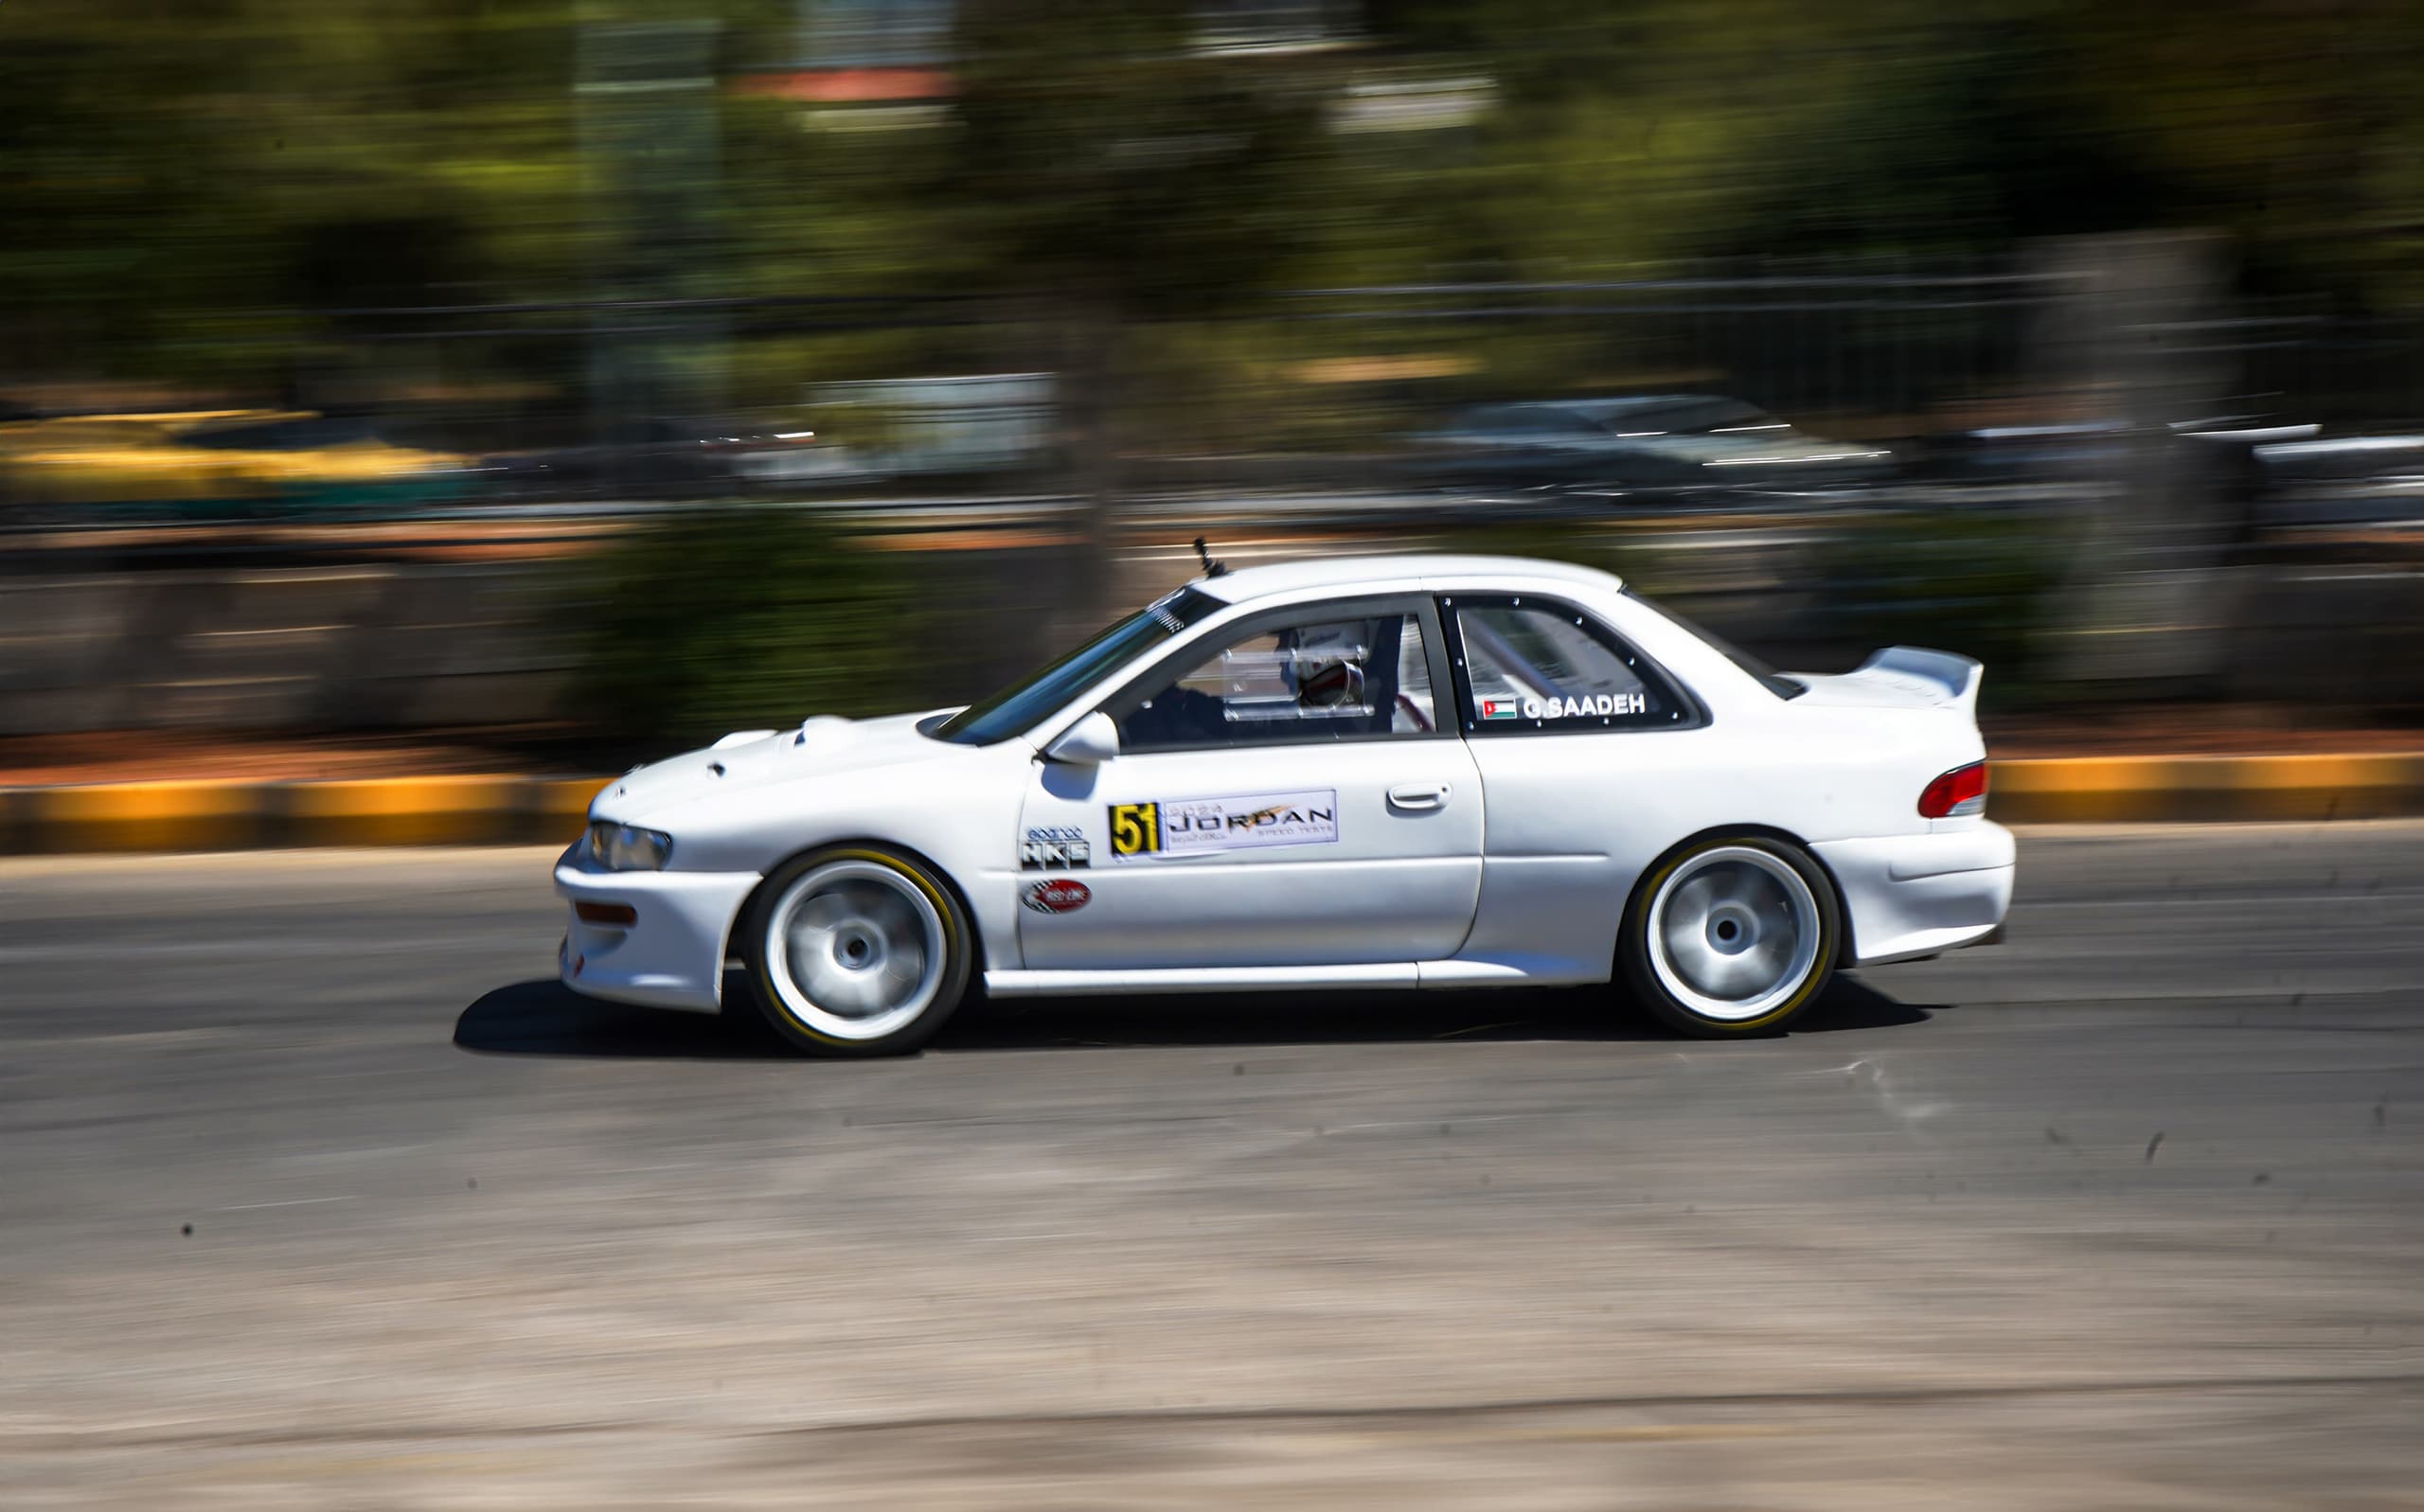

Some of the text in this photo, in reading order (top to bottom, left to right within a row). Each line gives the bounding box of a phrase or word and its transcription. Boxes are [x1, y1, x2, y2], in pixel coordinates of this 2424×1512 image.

[1113, 803, 1159, 855] 51
[1169, 808, 1333, 832] JORDAN
[1021, 842, 1091, 869] HKS
